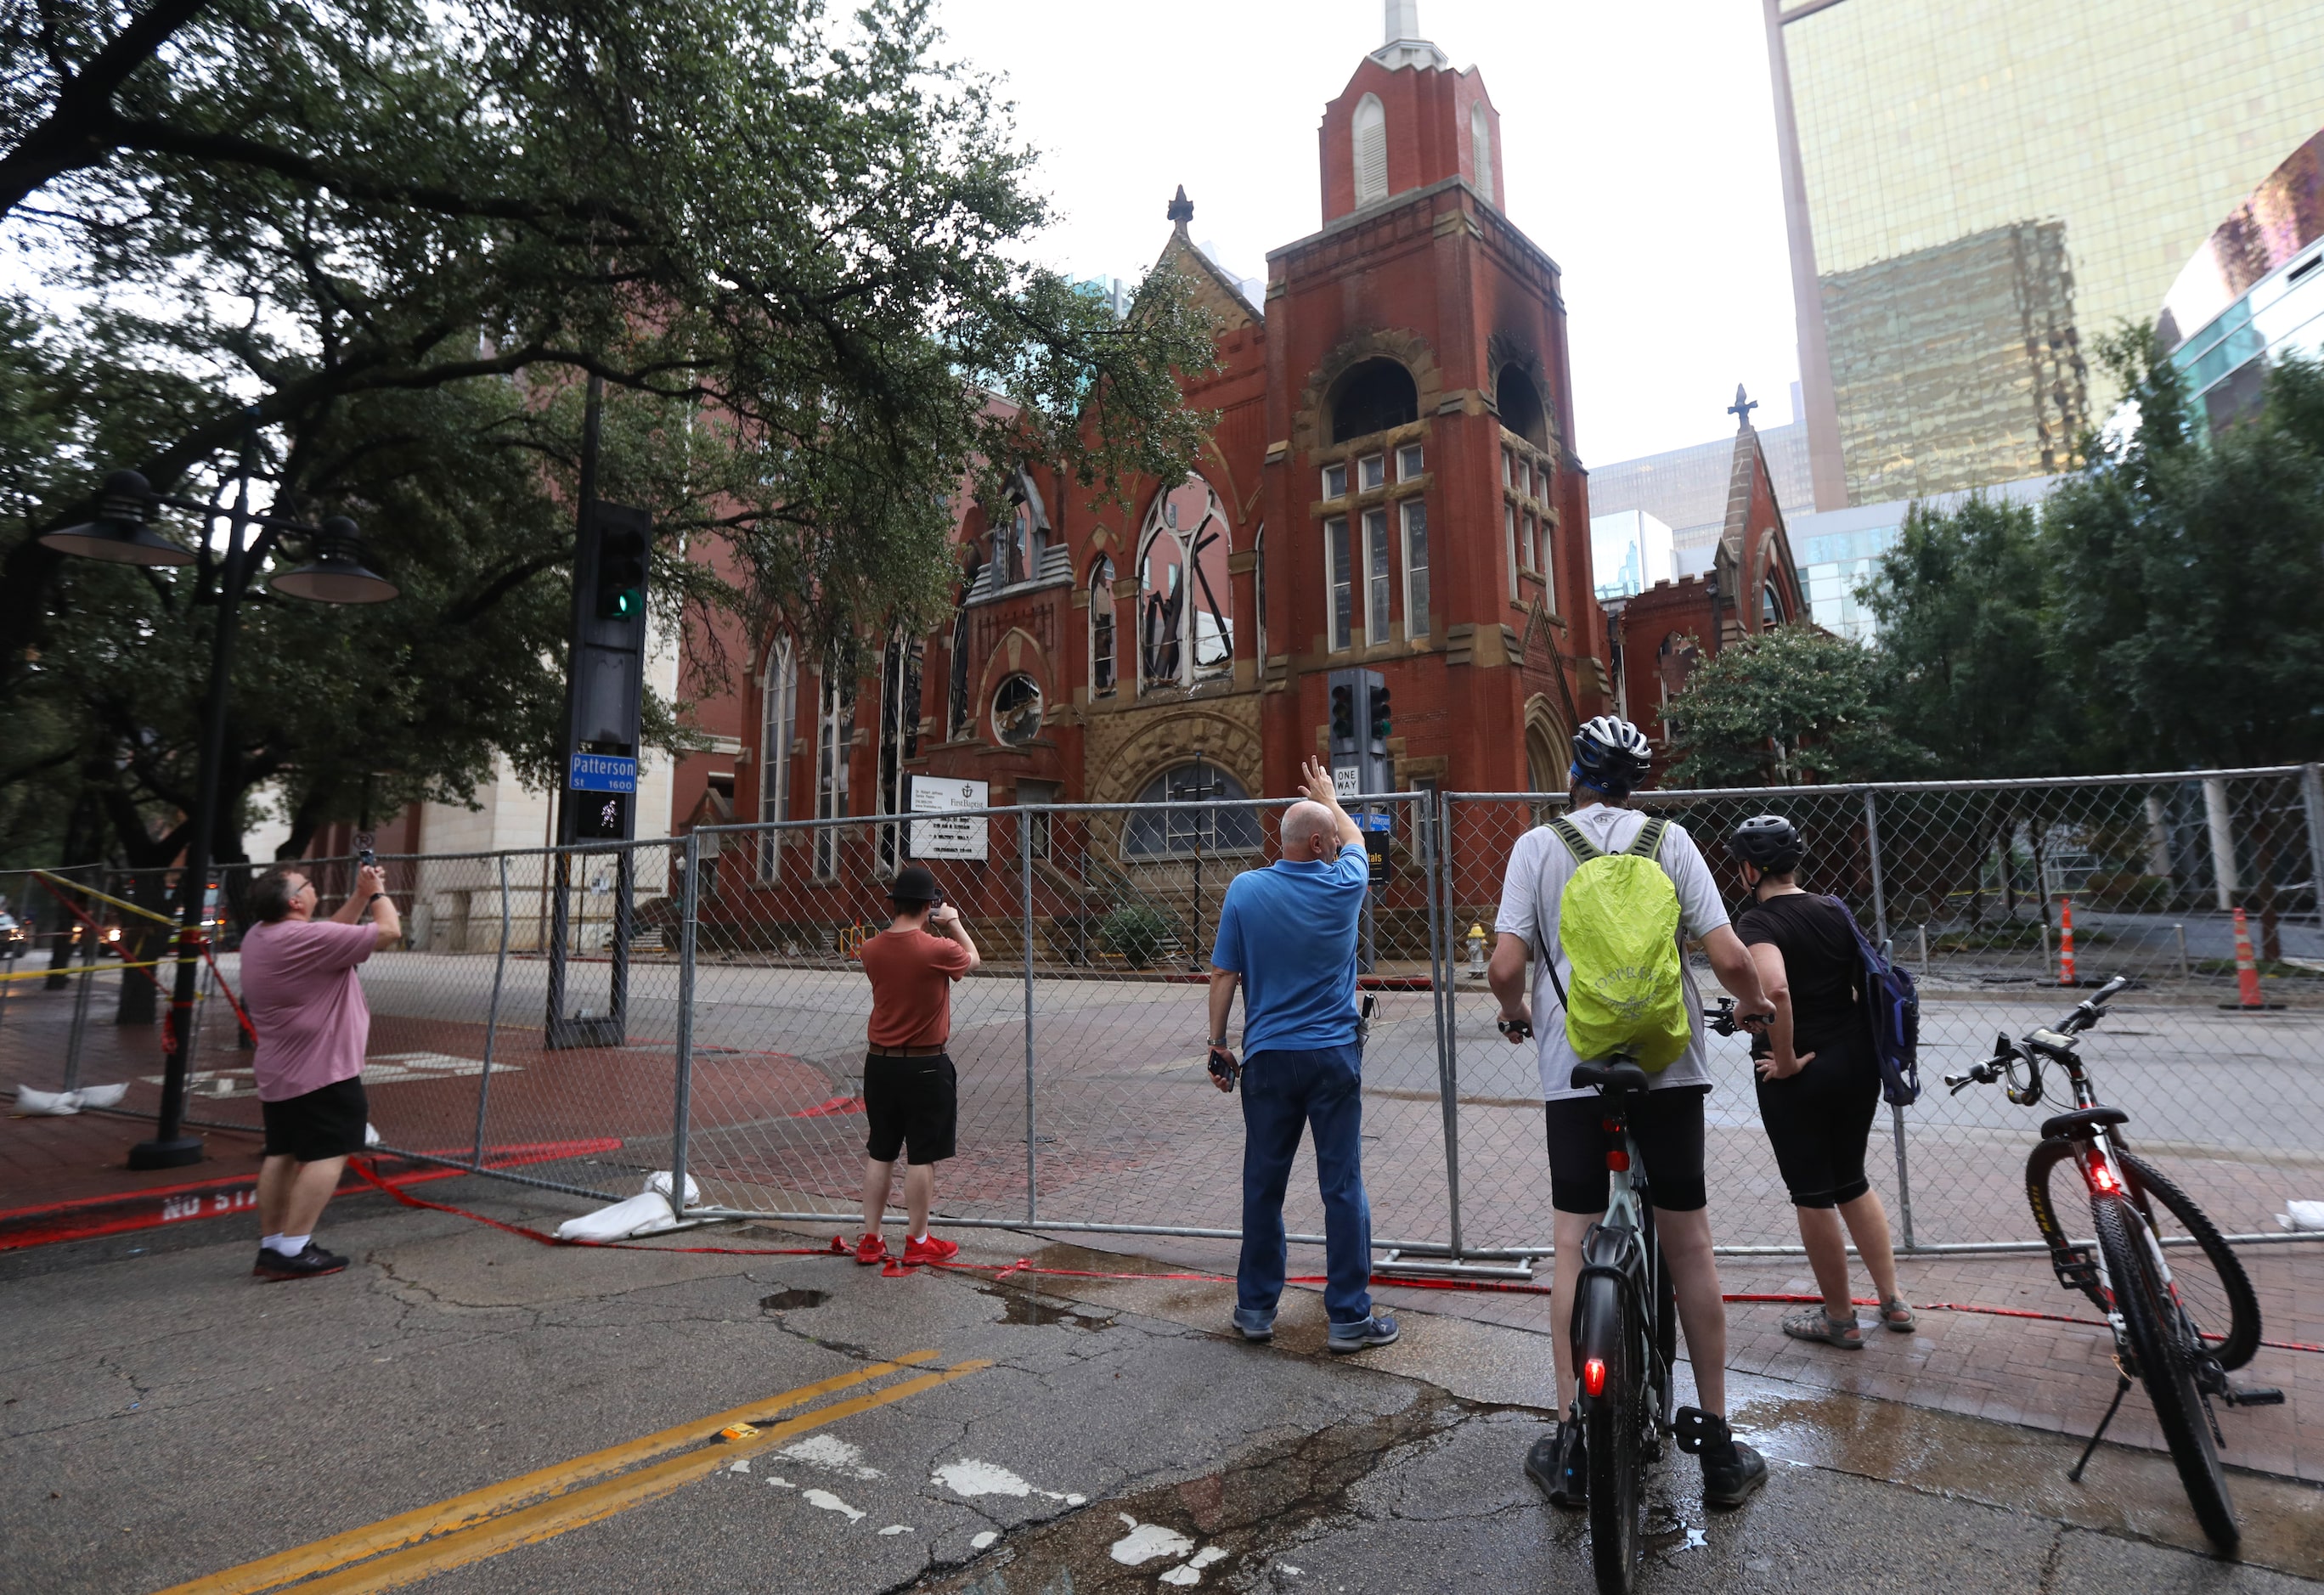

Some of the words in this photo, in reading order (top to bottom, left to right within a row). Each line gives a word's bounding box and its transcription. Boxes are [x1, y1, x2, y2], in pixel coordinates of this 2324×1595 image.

[574, 757, 634, 776] Patterson
[1338, 770, 1356, 781] ONE
[573, 778, 584, 787] St
[608, 780, 632, 790] 1600
[1337, 781, 1357, 790] WAY
[950, 798, 963, 807] First
[963, 799, 984, 809] Baptist
[1594, 966, 1658, 989] OSPREY
[163, 1194, 200, 1220] NO
[2031, 1185, 2052, 1232] MAXXIS
